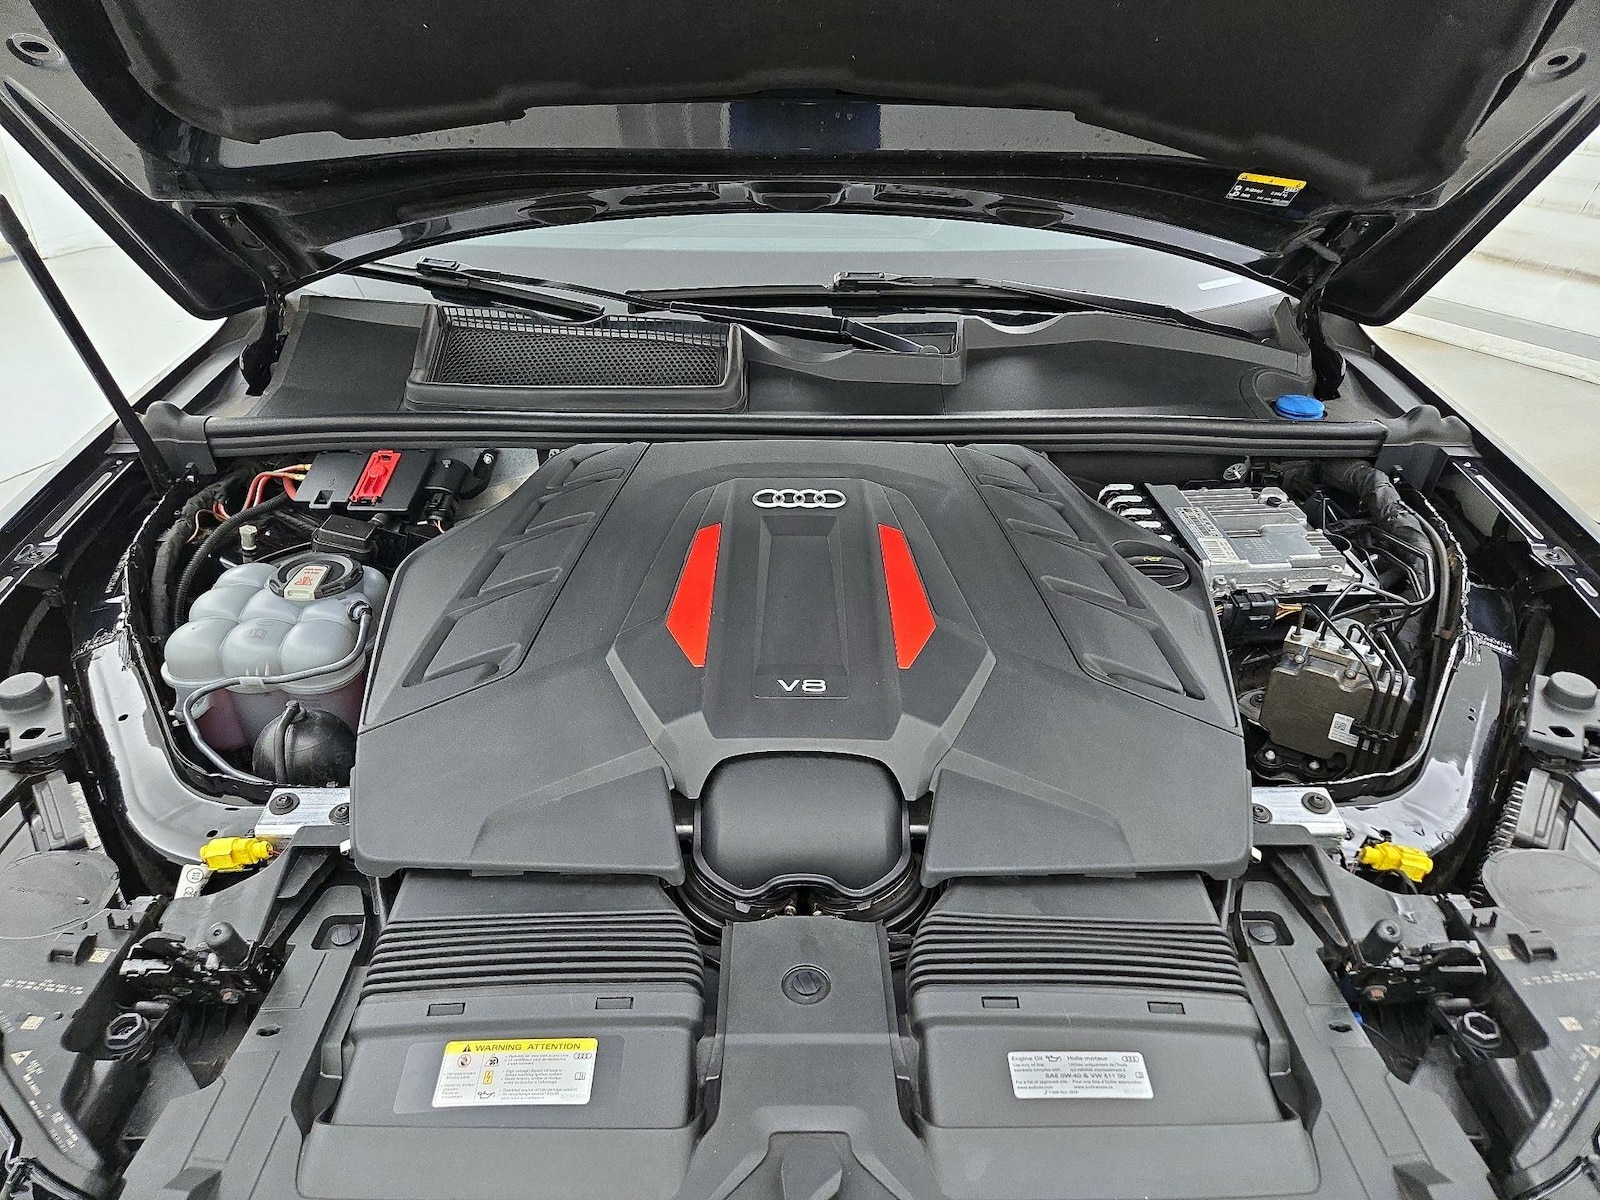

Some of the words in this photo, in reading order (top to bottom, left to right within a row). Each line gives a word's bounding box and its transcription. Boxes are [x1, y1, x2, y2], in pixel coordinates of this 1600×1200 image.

[777, 679, 827, 692] V8
[475, 1043, 522, 1052] WARNING
[527, 1042, 581, 1051] ATTENTION
